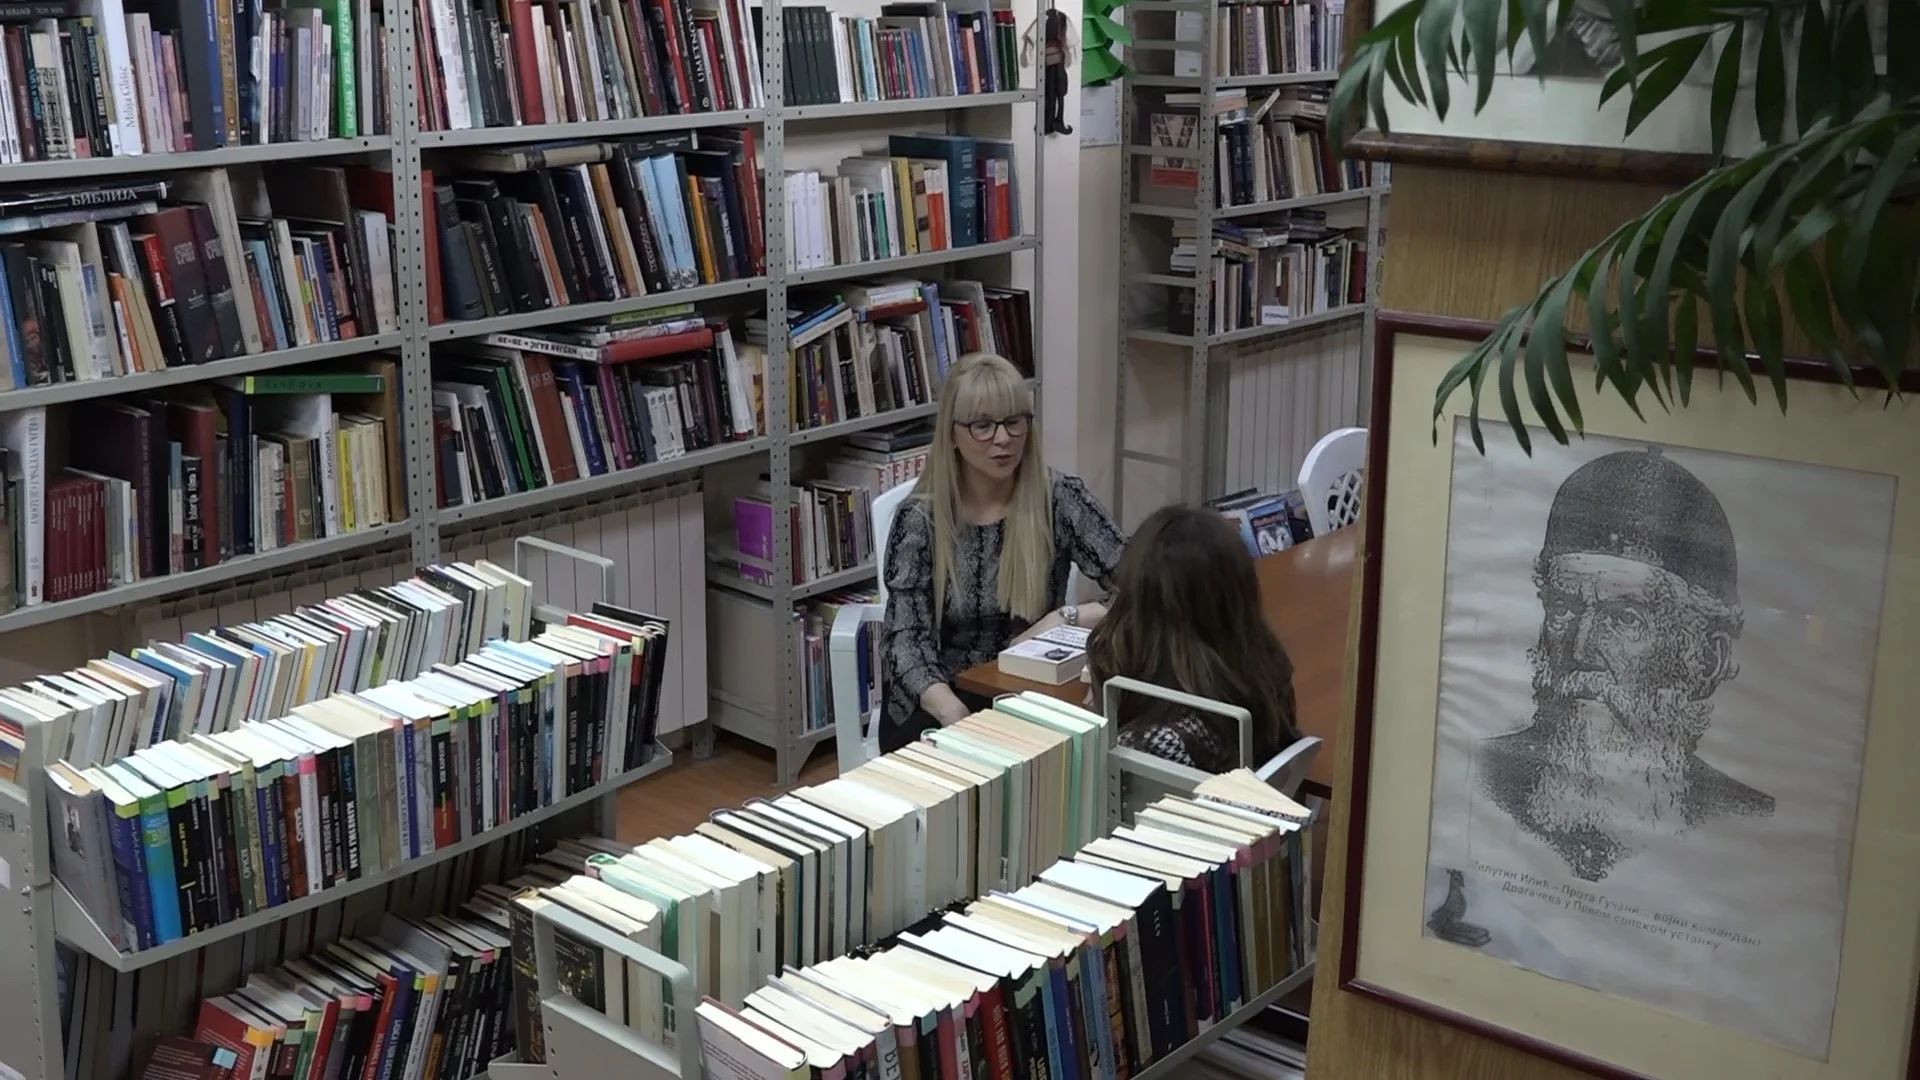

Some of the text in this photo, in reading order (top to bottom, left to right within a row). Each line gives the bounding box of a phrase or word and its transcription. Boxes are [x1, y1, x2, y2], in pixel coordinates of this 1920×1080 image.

[71, 188, 137, 206] БИБЛИЈА
[1519, 871, 1550, 889] Илић
[1561, 884, 1596, 903] Прота
[1502, 880, 1562, 905] Драгачева
[1613, 914, 1667, 936] српском
[1670, 930, 1721, 951] устанку
